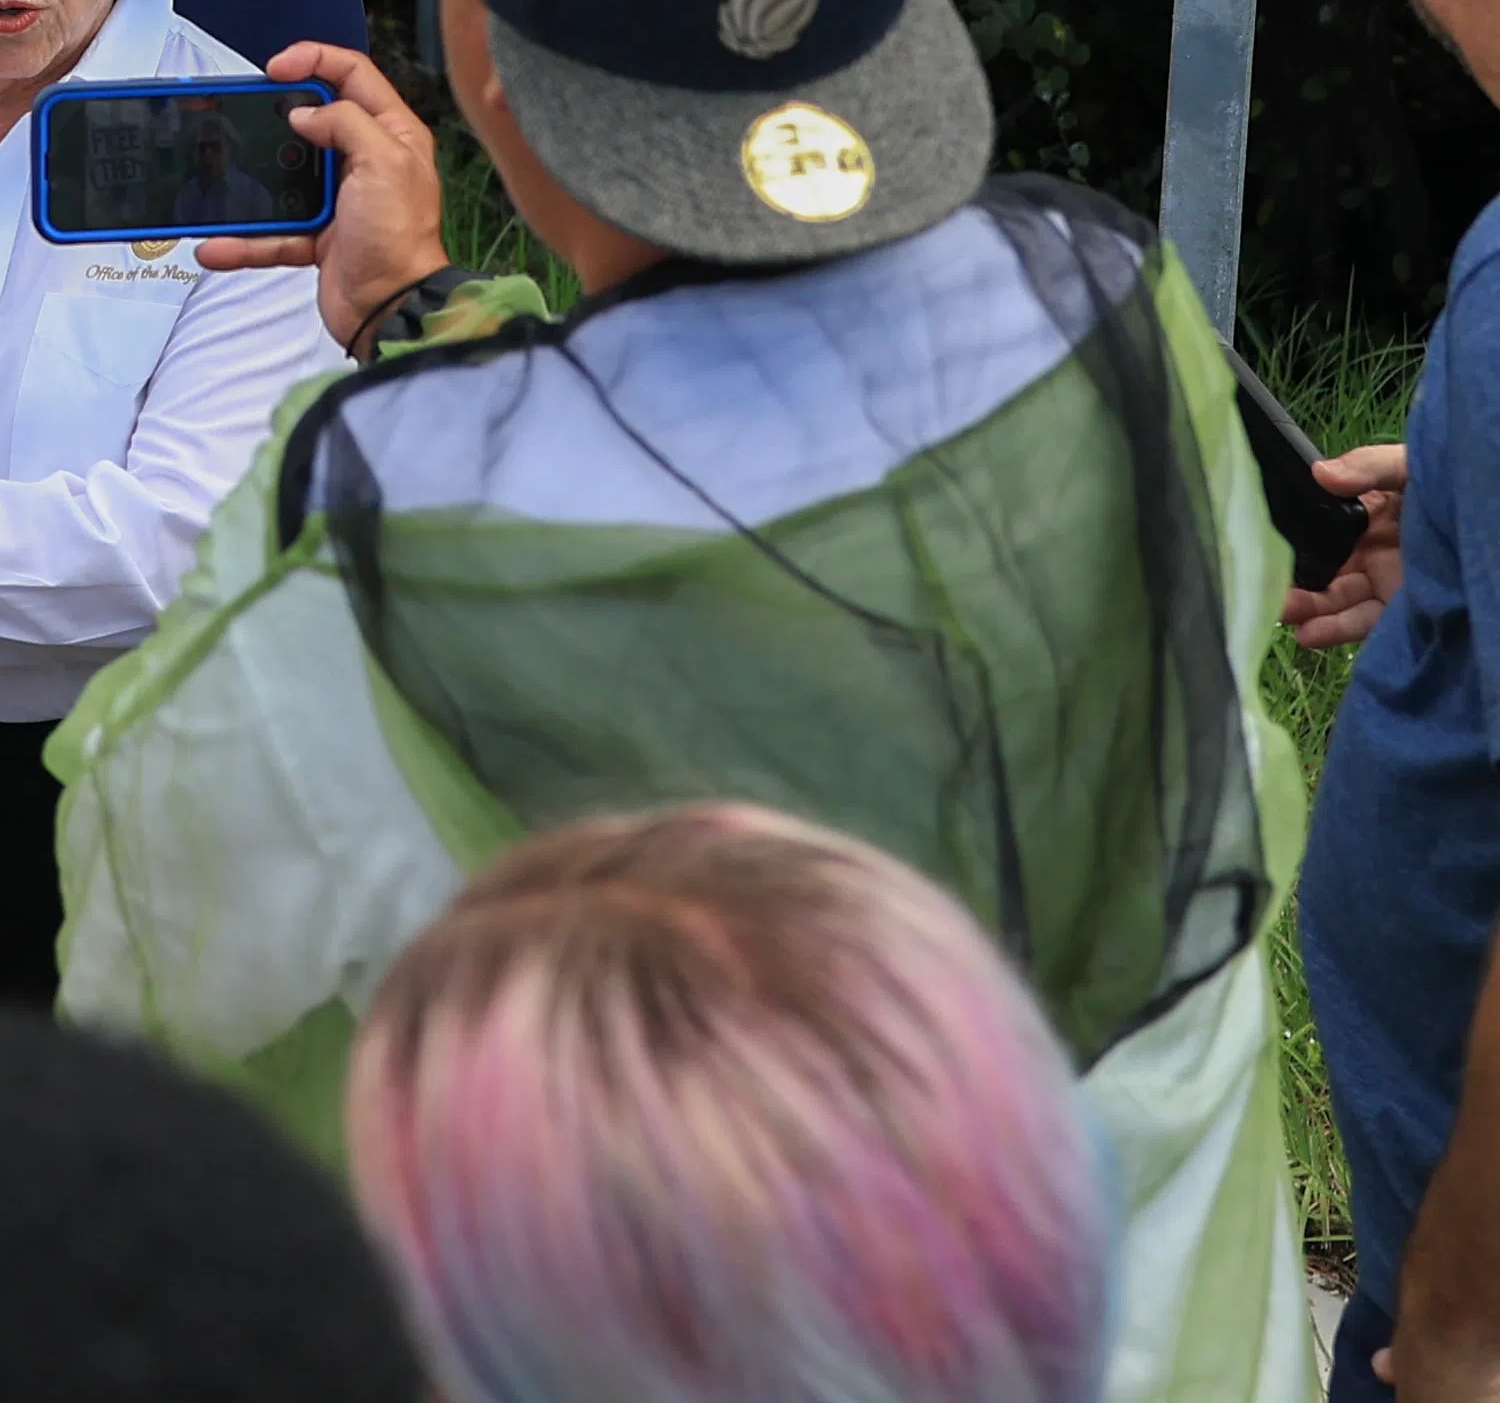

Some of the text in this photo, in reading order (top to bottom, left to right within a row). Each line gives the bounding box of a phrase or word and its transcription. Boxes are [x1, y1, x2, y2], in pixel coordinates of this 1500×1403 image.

[85, 264, 202, 286] Office of the Mayo
